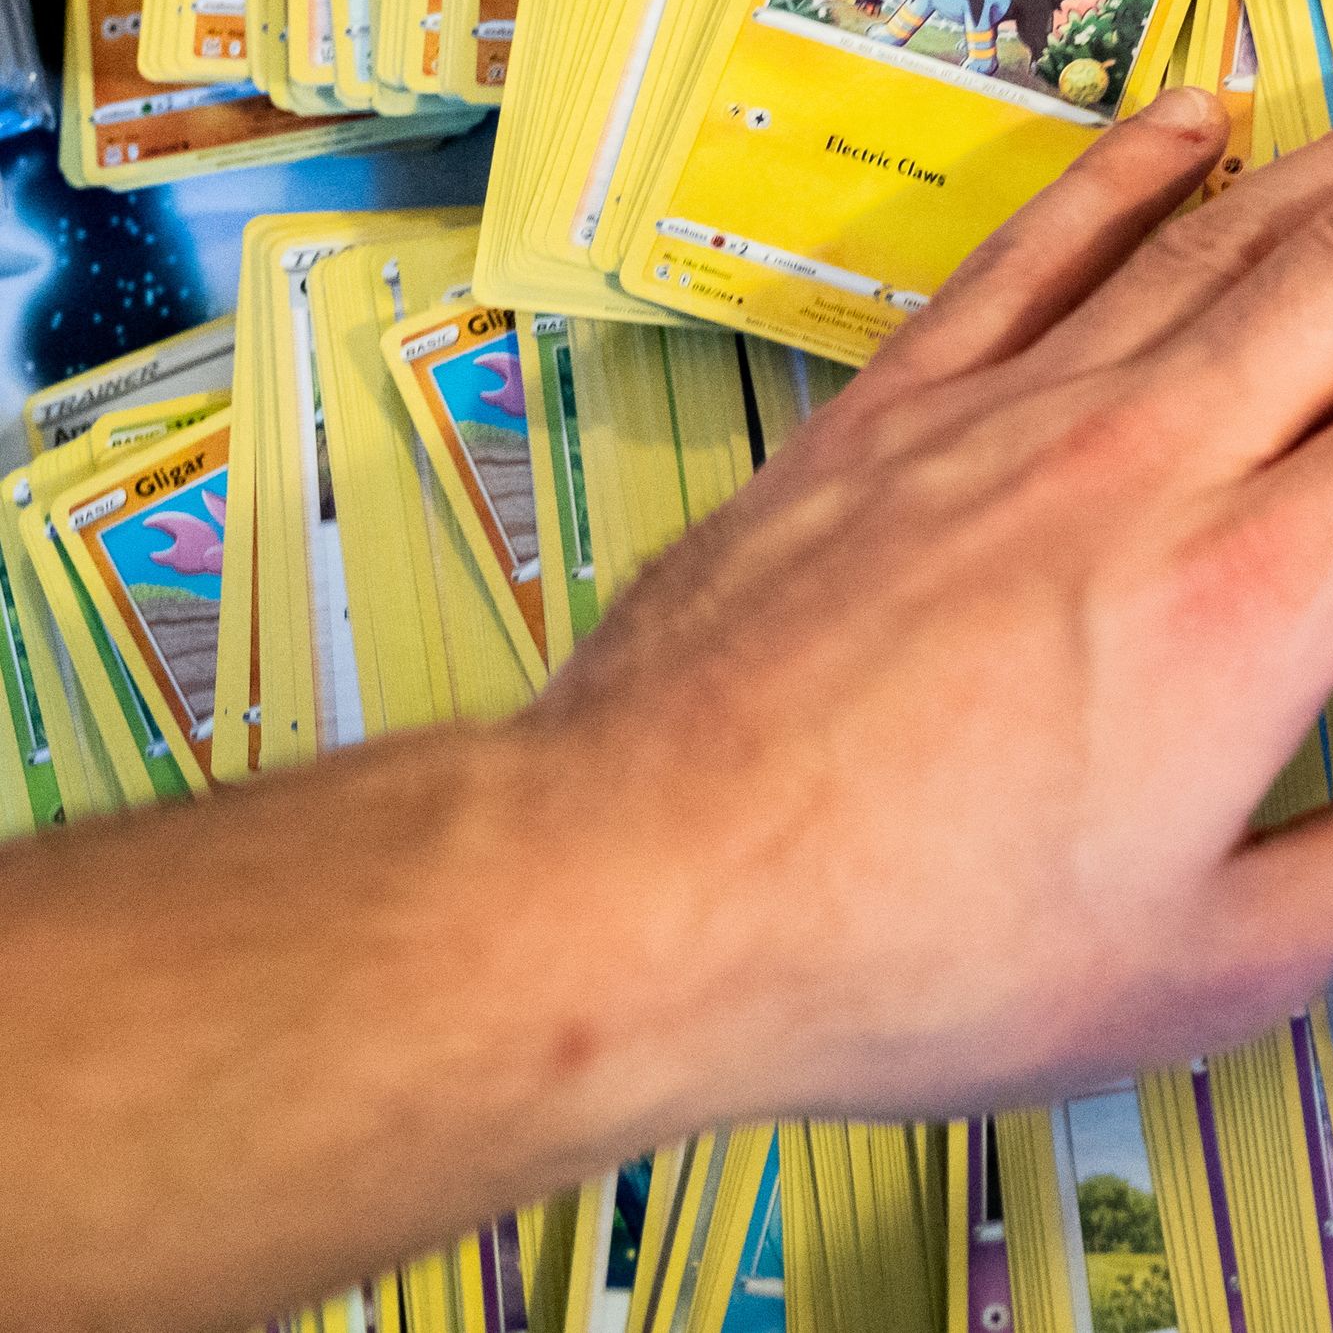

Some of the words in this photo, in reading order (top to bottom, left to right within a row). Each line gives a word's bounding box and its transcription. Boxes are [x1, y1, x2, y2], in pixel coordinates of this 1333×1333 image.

[825, 134, 890, 169] Electric
[897, 157, 947, 188] Claws
[41, 360, 159, 416] TRAINER
[134, 450, 206, 498] Gligar
